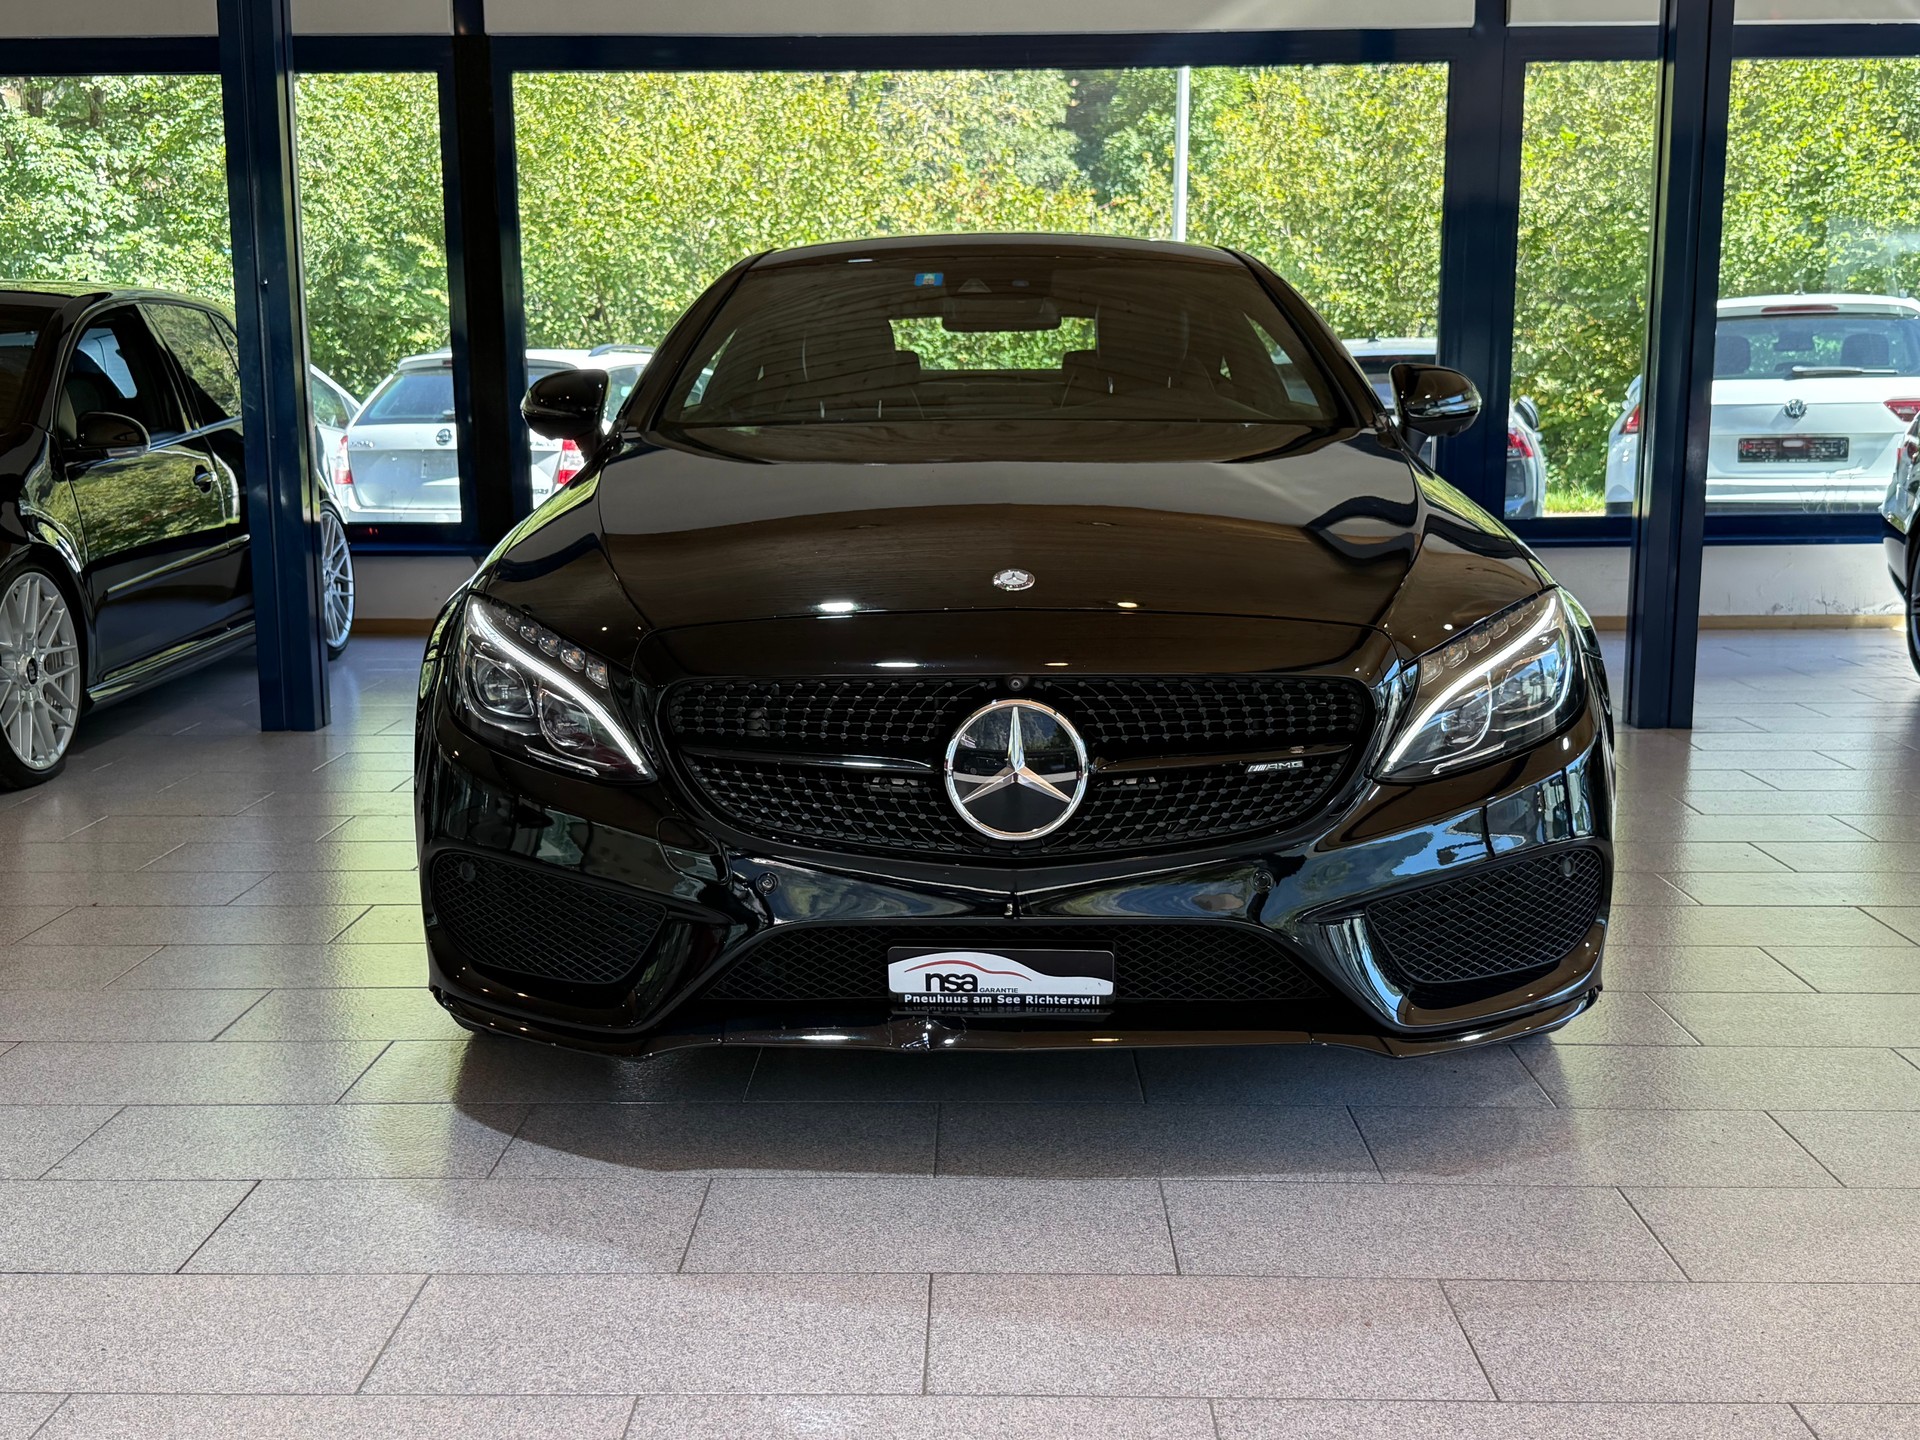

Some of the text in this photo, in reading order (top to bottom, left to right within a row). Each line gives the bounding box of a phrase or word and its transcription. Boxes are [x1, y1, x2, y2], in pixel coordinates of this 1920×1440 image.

[925, 973, 979, 992] nsa
[904, 994, 1100, 1005] Pneuhuus am See Richterswil
